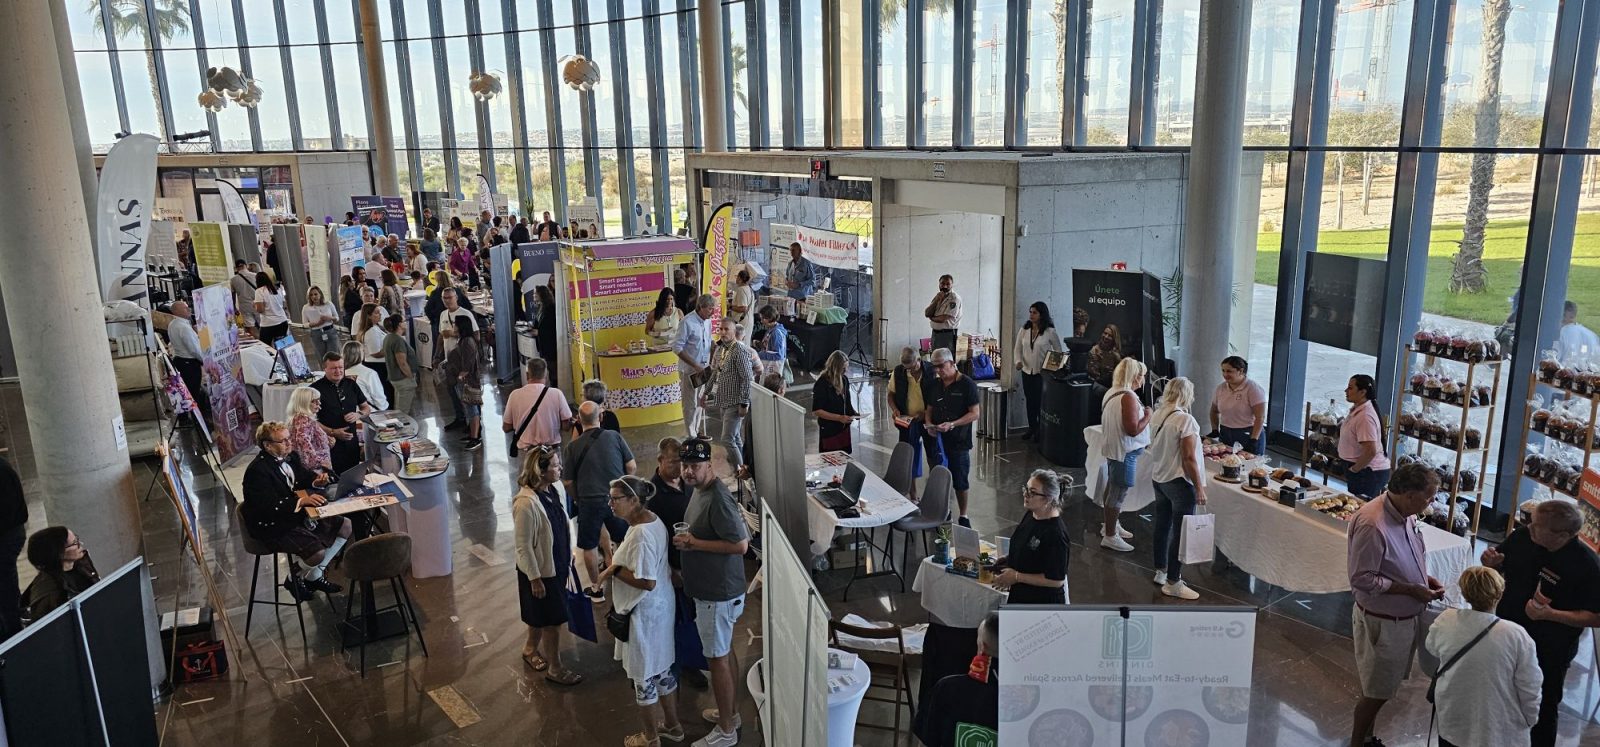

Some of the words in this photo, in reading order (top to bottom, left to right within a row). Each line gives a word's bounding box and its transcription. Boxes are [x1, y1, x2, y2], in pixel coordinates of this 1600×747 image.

[709, 217, 727, 277] Puzzles
[616, 276, 637, 284] puzzles
[612, 286, 643, 294] advertisers
[1095, 284, 1120, 294] Únete
[1088, 296, 1096, 304] al
[1096, 297, 1126, 306] equipo
